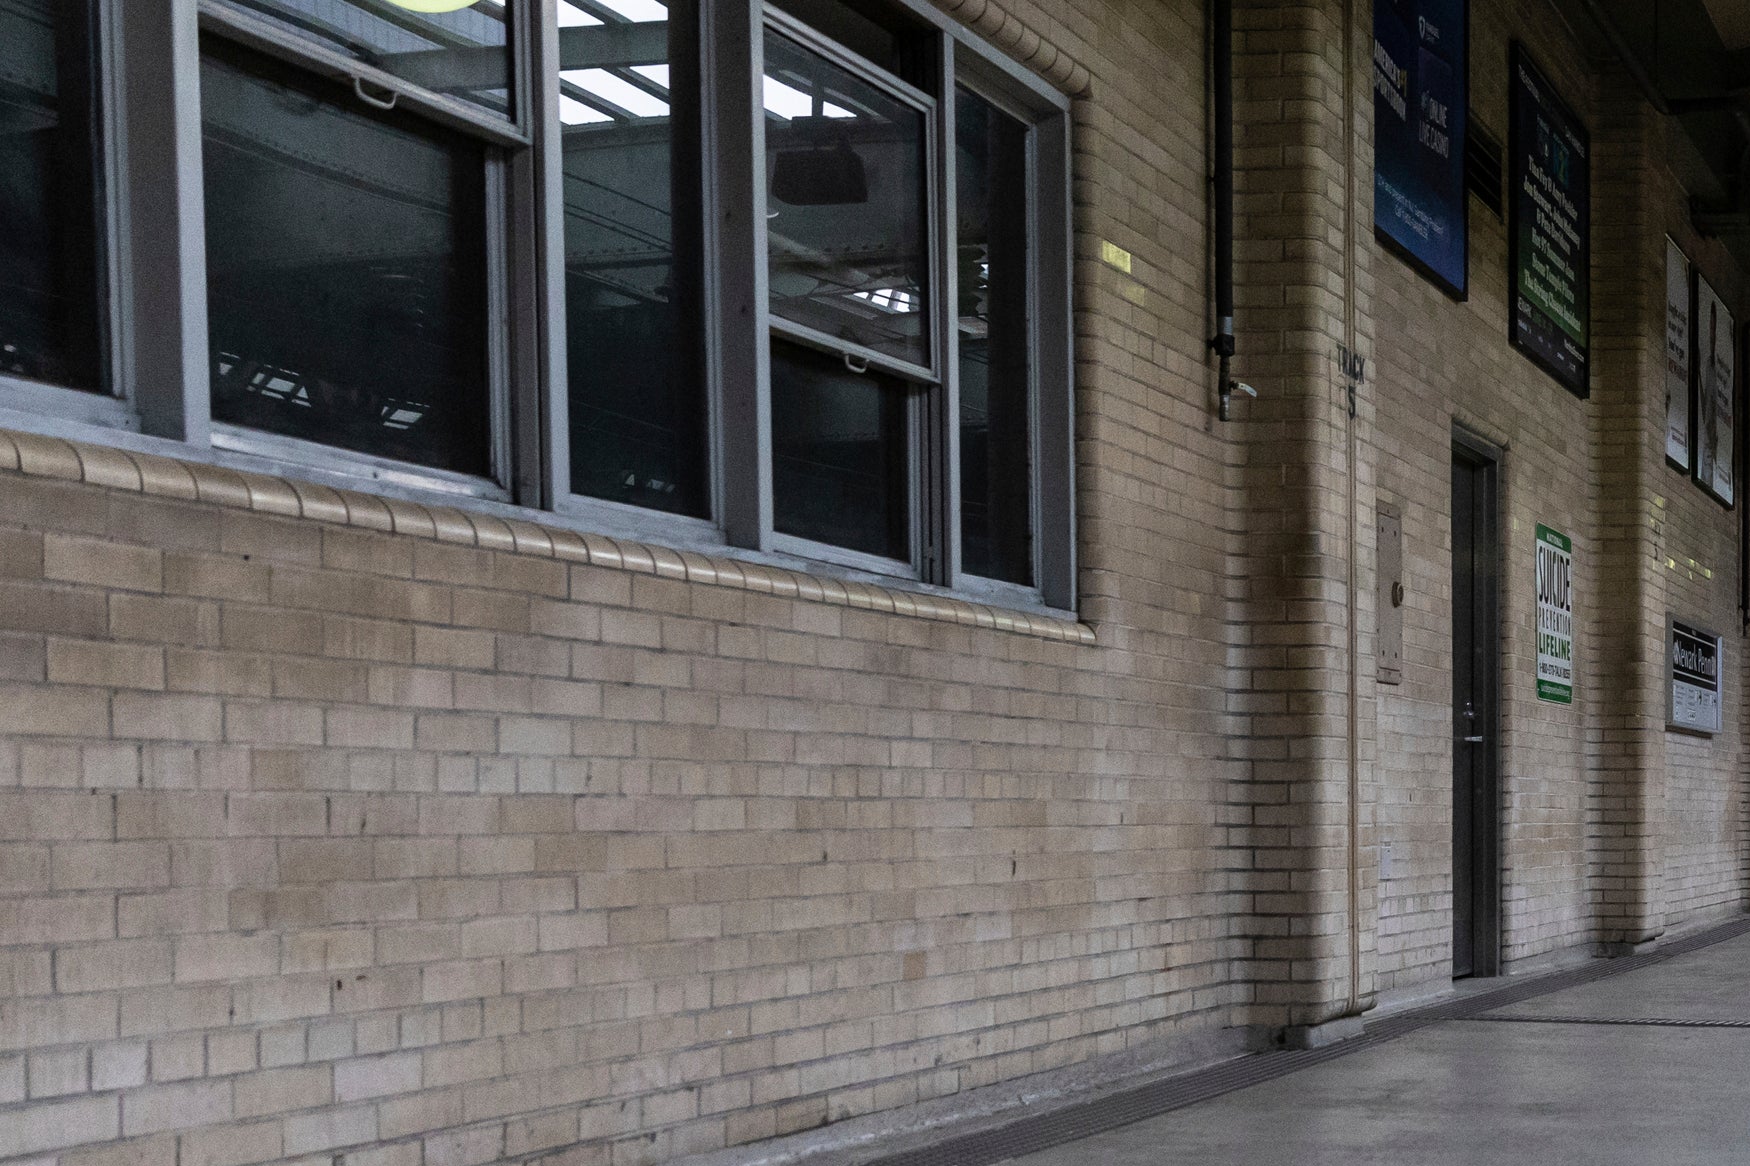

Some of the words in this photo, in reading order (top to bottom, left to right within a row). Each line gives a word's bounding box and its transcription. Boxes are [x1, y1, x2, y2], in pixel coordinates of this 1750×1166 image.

[1337, 343, 1365, 385] TRACK
[1538, 546, 1571, 612] SUICIDE
[1538, 606, 1571, 637] PREVENTION
[1538, 632, 1571, 662] LIFELINE
[1676, 640, 1697, 672] Newark
[1698, 648, 1713, 676] Penn
